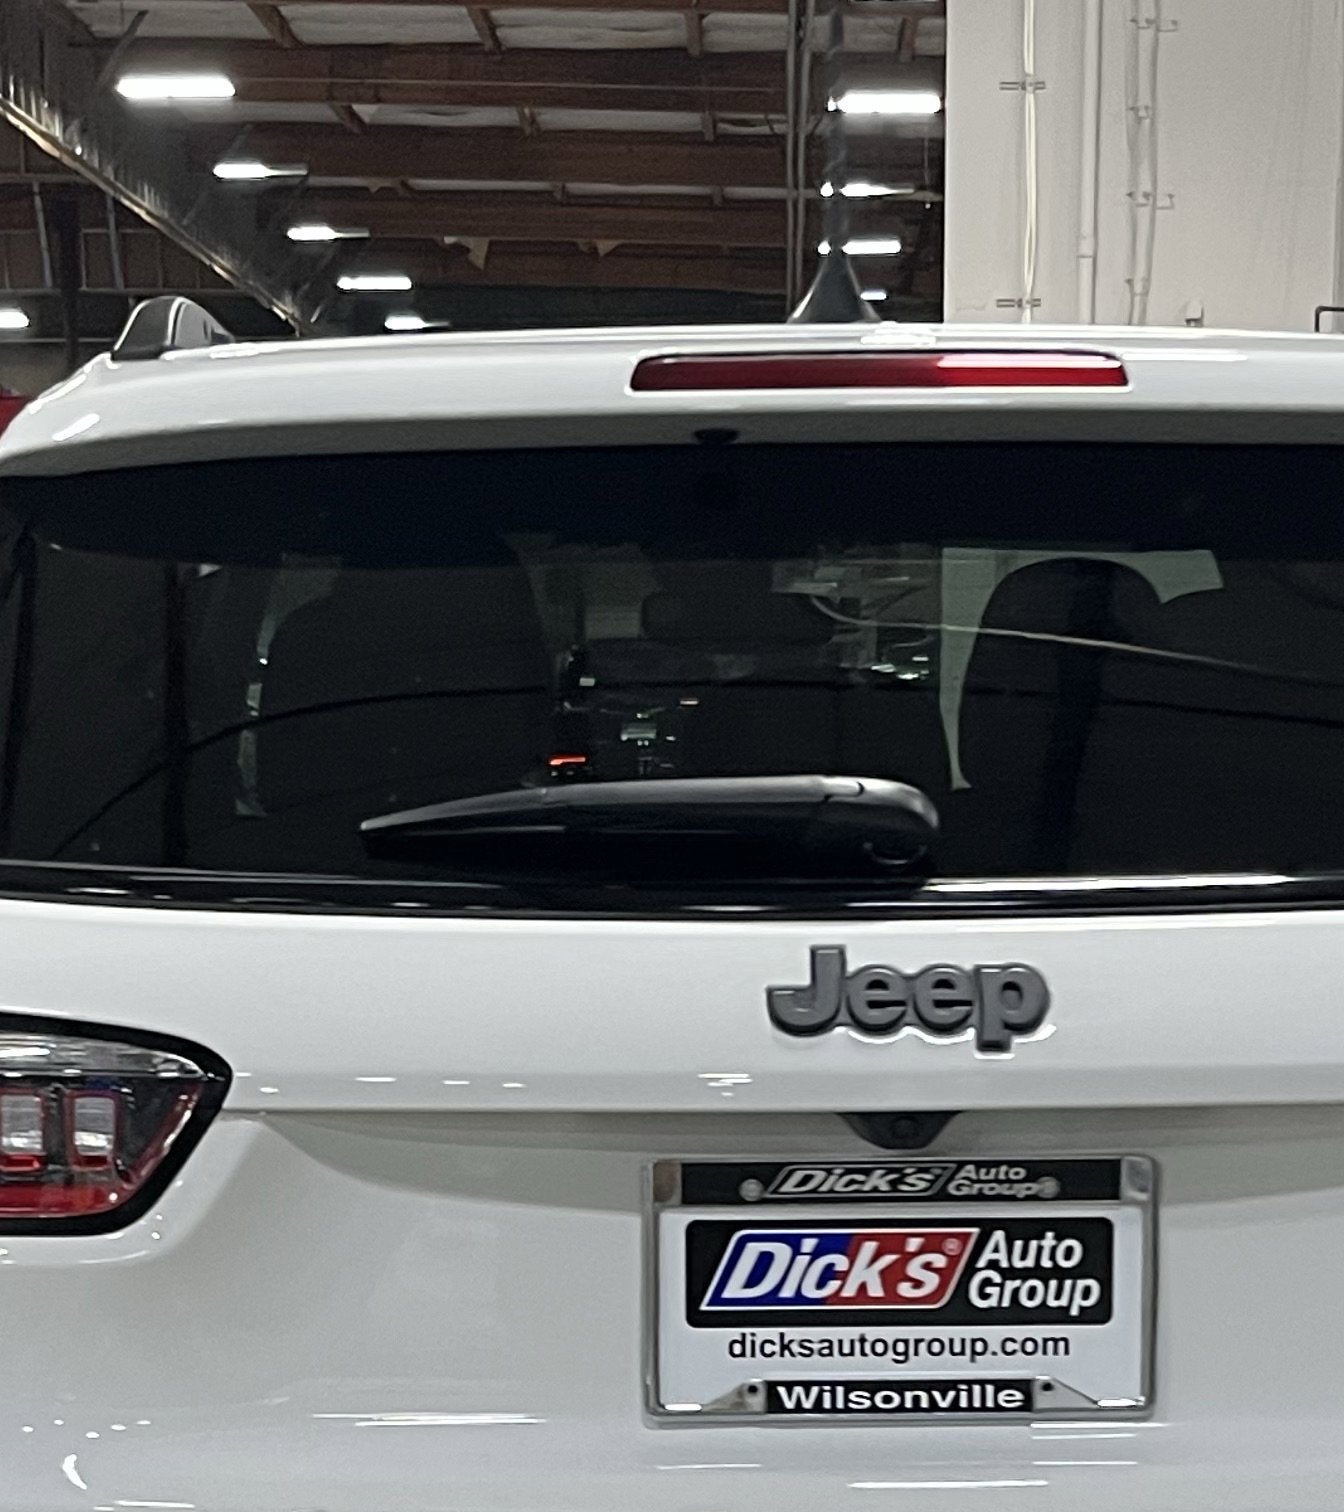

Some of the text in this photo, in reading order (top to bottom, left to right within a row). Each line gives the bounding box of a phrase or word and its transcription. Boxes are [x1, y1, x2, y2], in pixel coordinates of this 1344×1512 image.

[766, 944, 1051, 1053] Jeep
[778, 1167, 936, 1193] Dick's
[958, 1163, 1026, 1180] Auto
[947, 1179, 1044, 1198] Group
[975, 1230, 1084, 1270] Auto
[720, 1238, 948, 1300] Dick's
[967, 1269, 1102, 1316] Group
[727, 1333, 1071, 1364] dicksautogroup.com
[776, 1383, 1025, 1409] Wilsonville
